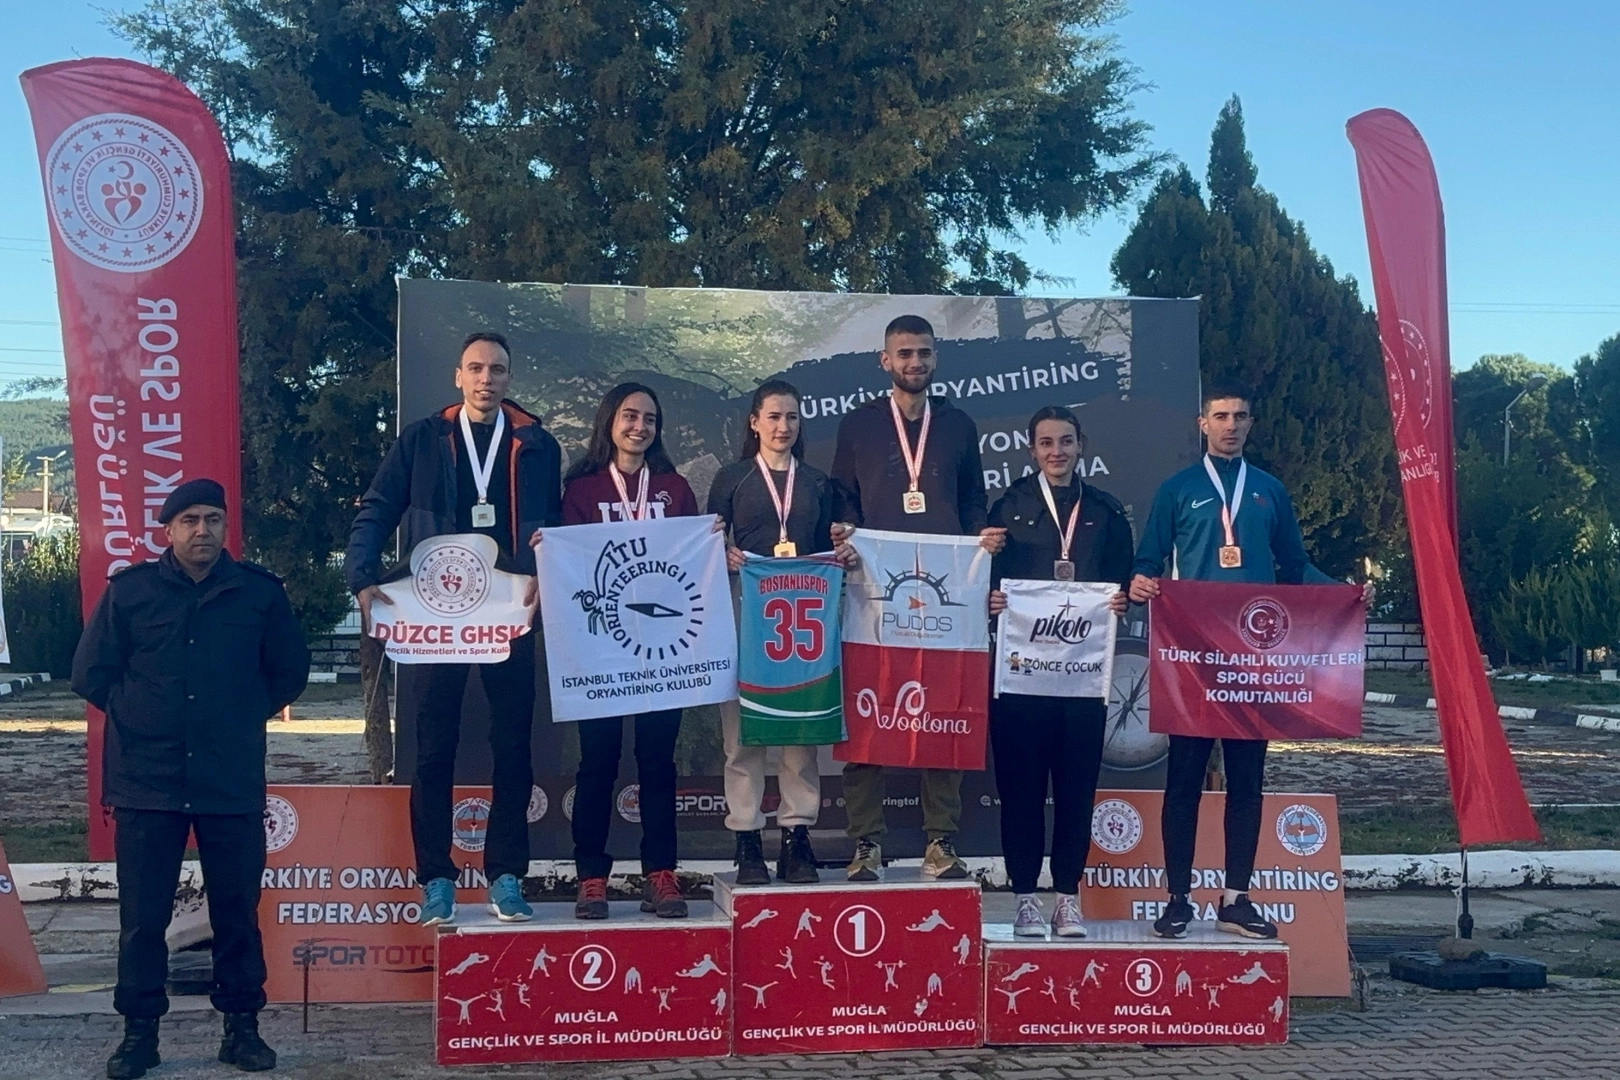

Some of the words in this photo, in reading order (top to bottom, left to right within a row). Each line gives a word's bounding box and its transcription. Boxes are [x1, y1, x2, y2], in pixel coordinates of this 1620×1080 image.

[926, 361, 1099, 399] RYANTİRİNG
[759, 574, 829, 595] BOSTANLISPOR
[605, 561, 680, 642] ORIENTEERING
[375, 621, 453, 643] DÜZCE
[461, 625, 525, 644] GHSK
[764, 597, 824, 662] 35
[882, 612, 953, 631] PUDOS
[1029, 608, 1092, 644] pikolo
[386, 647, 410, 655] ençlik
[412, 647, 455, 655] Hizmetleri
[470, 647, 489, 655] Spor
[1158, 646, 1201, 663] TÜRK
[1204, 650, 1264, 666] SİLAHLI
[1267, 649, 1362, 667] KUVVETLERİ
[562, 675, 615, 688] İSTANBUL
[618, 668, 657, 683] TEKNİK
[660, 659, 731, 678] ÜNİVERSİTESİ
[1033, 658, 1062, 672] ÖNCE
[1065, 661, 1102, 675] ÇOCUK
[1216, 671, 1259, 684] SPOR
[1262, 669, 1305, 685] GÜCÜ
[586, 682, 663, 700] ORYANTİRİNG
[1206, 687, 1313, 703] KOMUTANLIĞI
[854, 681, 971, 735] Woolona
[260, 862, 332, 888] RKİYE
[1083, 863, 1168, 888] TÜRKİY
[1190, 865, 1339, 891] ORYNTİRİNG
[278, 903, 421, 924] FEDERASYO
[848, 911, 866, 950] 1
[582, 951, 602, 985] 2
[1136, 964, 1152, 991] 3
[554, 1009, 618, 1024] MUĞLA
[832, 1004, 887, 1017] MUĞLA
[1114, 1003, 1171, 1016] MUĞLA
[448, 1034, 520, 1051] GENÇLİK
[523, 1035, 544, 1046] VE
[548, 1033, 592, 1046] SPOR
[596, 1029, 610, 1044] İL
[614, 1028, 722, 1044] MÜDÜRLÜĞÜ
[742, 1026, 803, 1041] GENÇLİK
[806, 1026, 824, 1037] VE
[827, 1025, 865, 1036] SPOR
[868, 1022, 880, 1034] İL
[883, 1019, 976, 1033] MÜDÜRLÜĞÜ
[1019, 1021, 1083, 1037] GENÇLİK
[1087, 1024, 1105, 1035] VE
[1109, 1024, 1148, 1035] SPOR
[1151, 1021, 1164, 1034] İL
[1168, 1021, 1265, 1036] MÜDÜRLÜĞÜ
